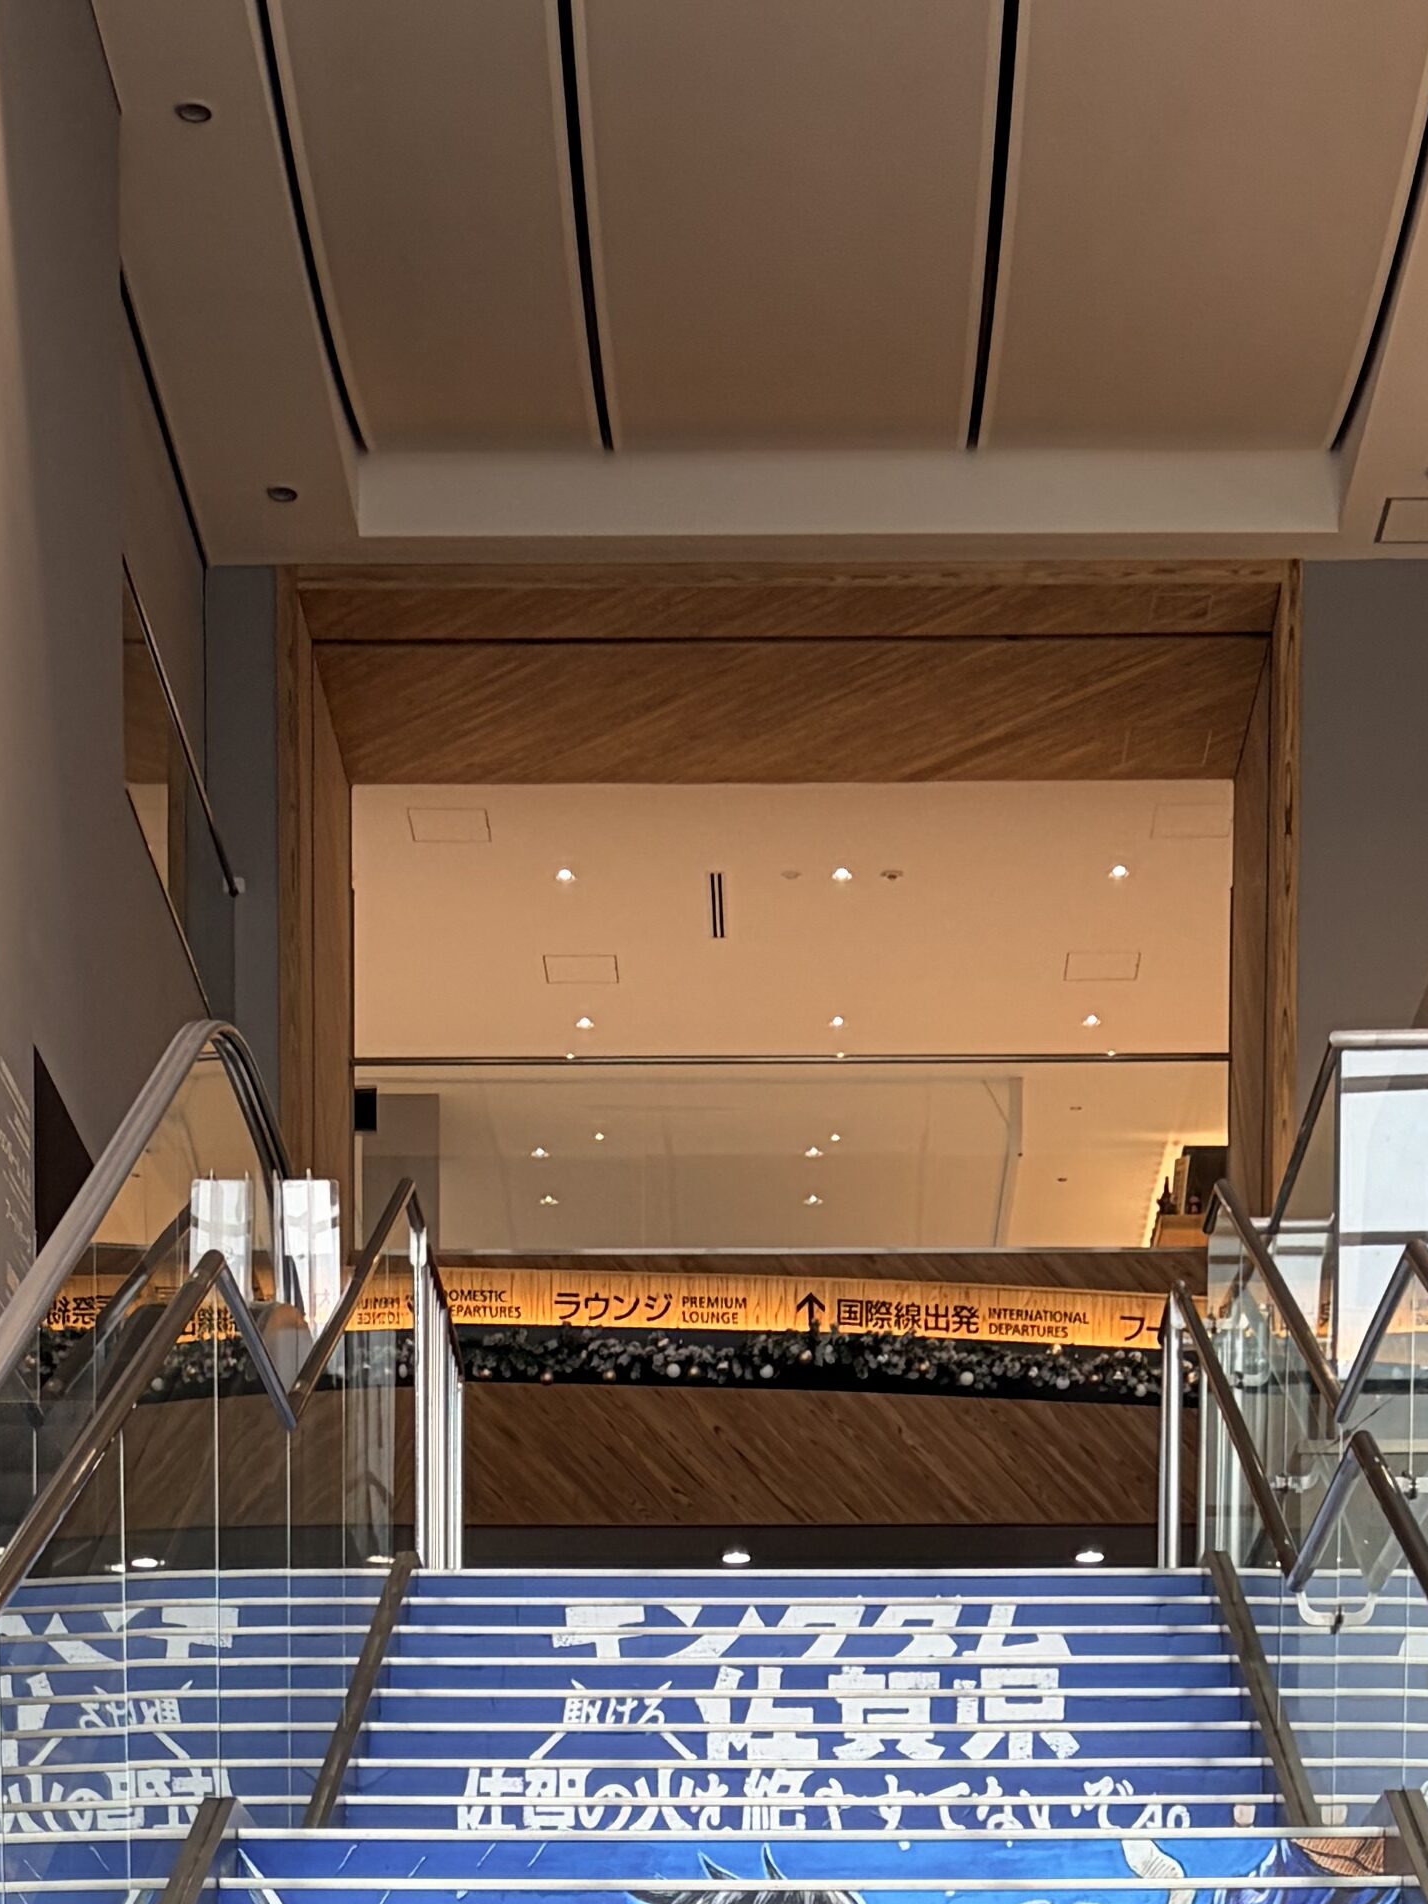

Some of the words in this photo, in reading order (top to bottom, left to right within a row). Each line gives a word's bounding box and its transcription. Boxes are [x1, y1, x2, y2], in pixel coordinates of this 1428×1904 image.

[445, 1289, 507, 1302] OMESTIC
[682, 1295, 747, 1310] PREMIUM
[448, 1305, 521, 1319] EPARTURES
[554, 1291, 673, 1321] ラウンジ
[682, 1311, 740, 1324] LOUNGE
[836, 1298, 980, 1334] 国際線出発
[988, 1306, 1089, 1325] INTERNATIONAL
[988, 1322, 1068, 1339] DEPARTURES
[694, 1664, 1081, 1761] 佐賀県
